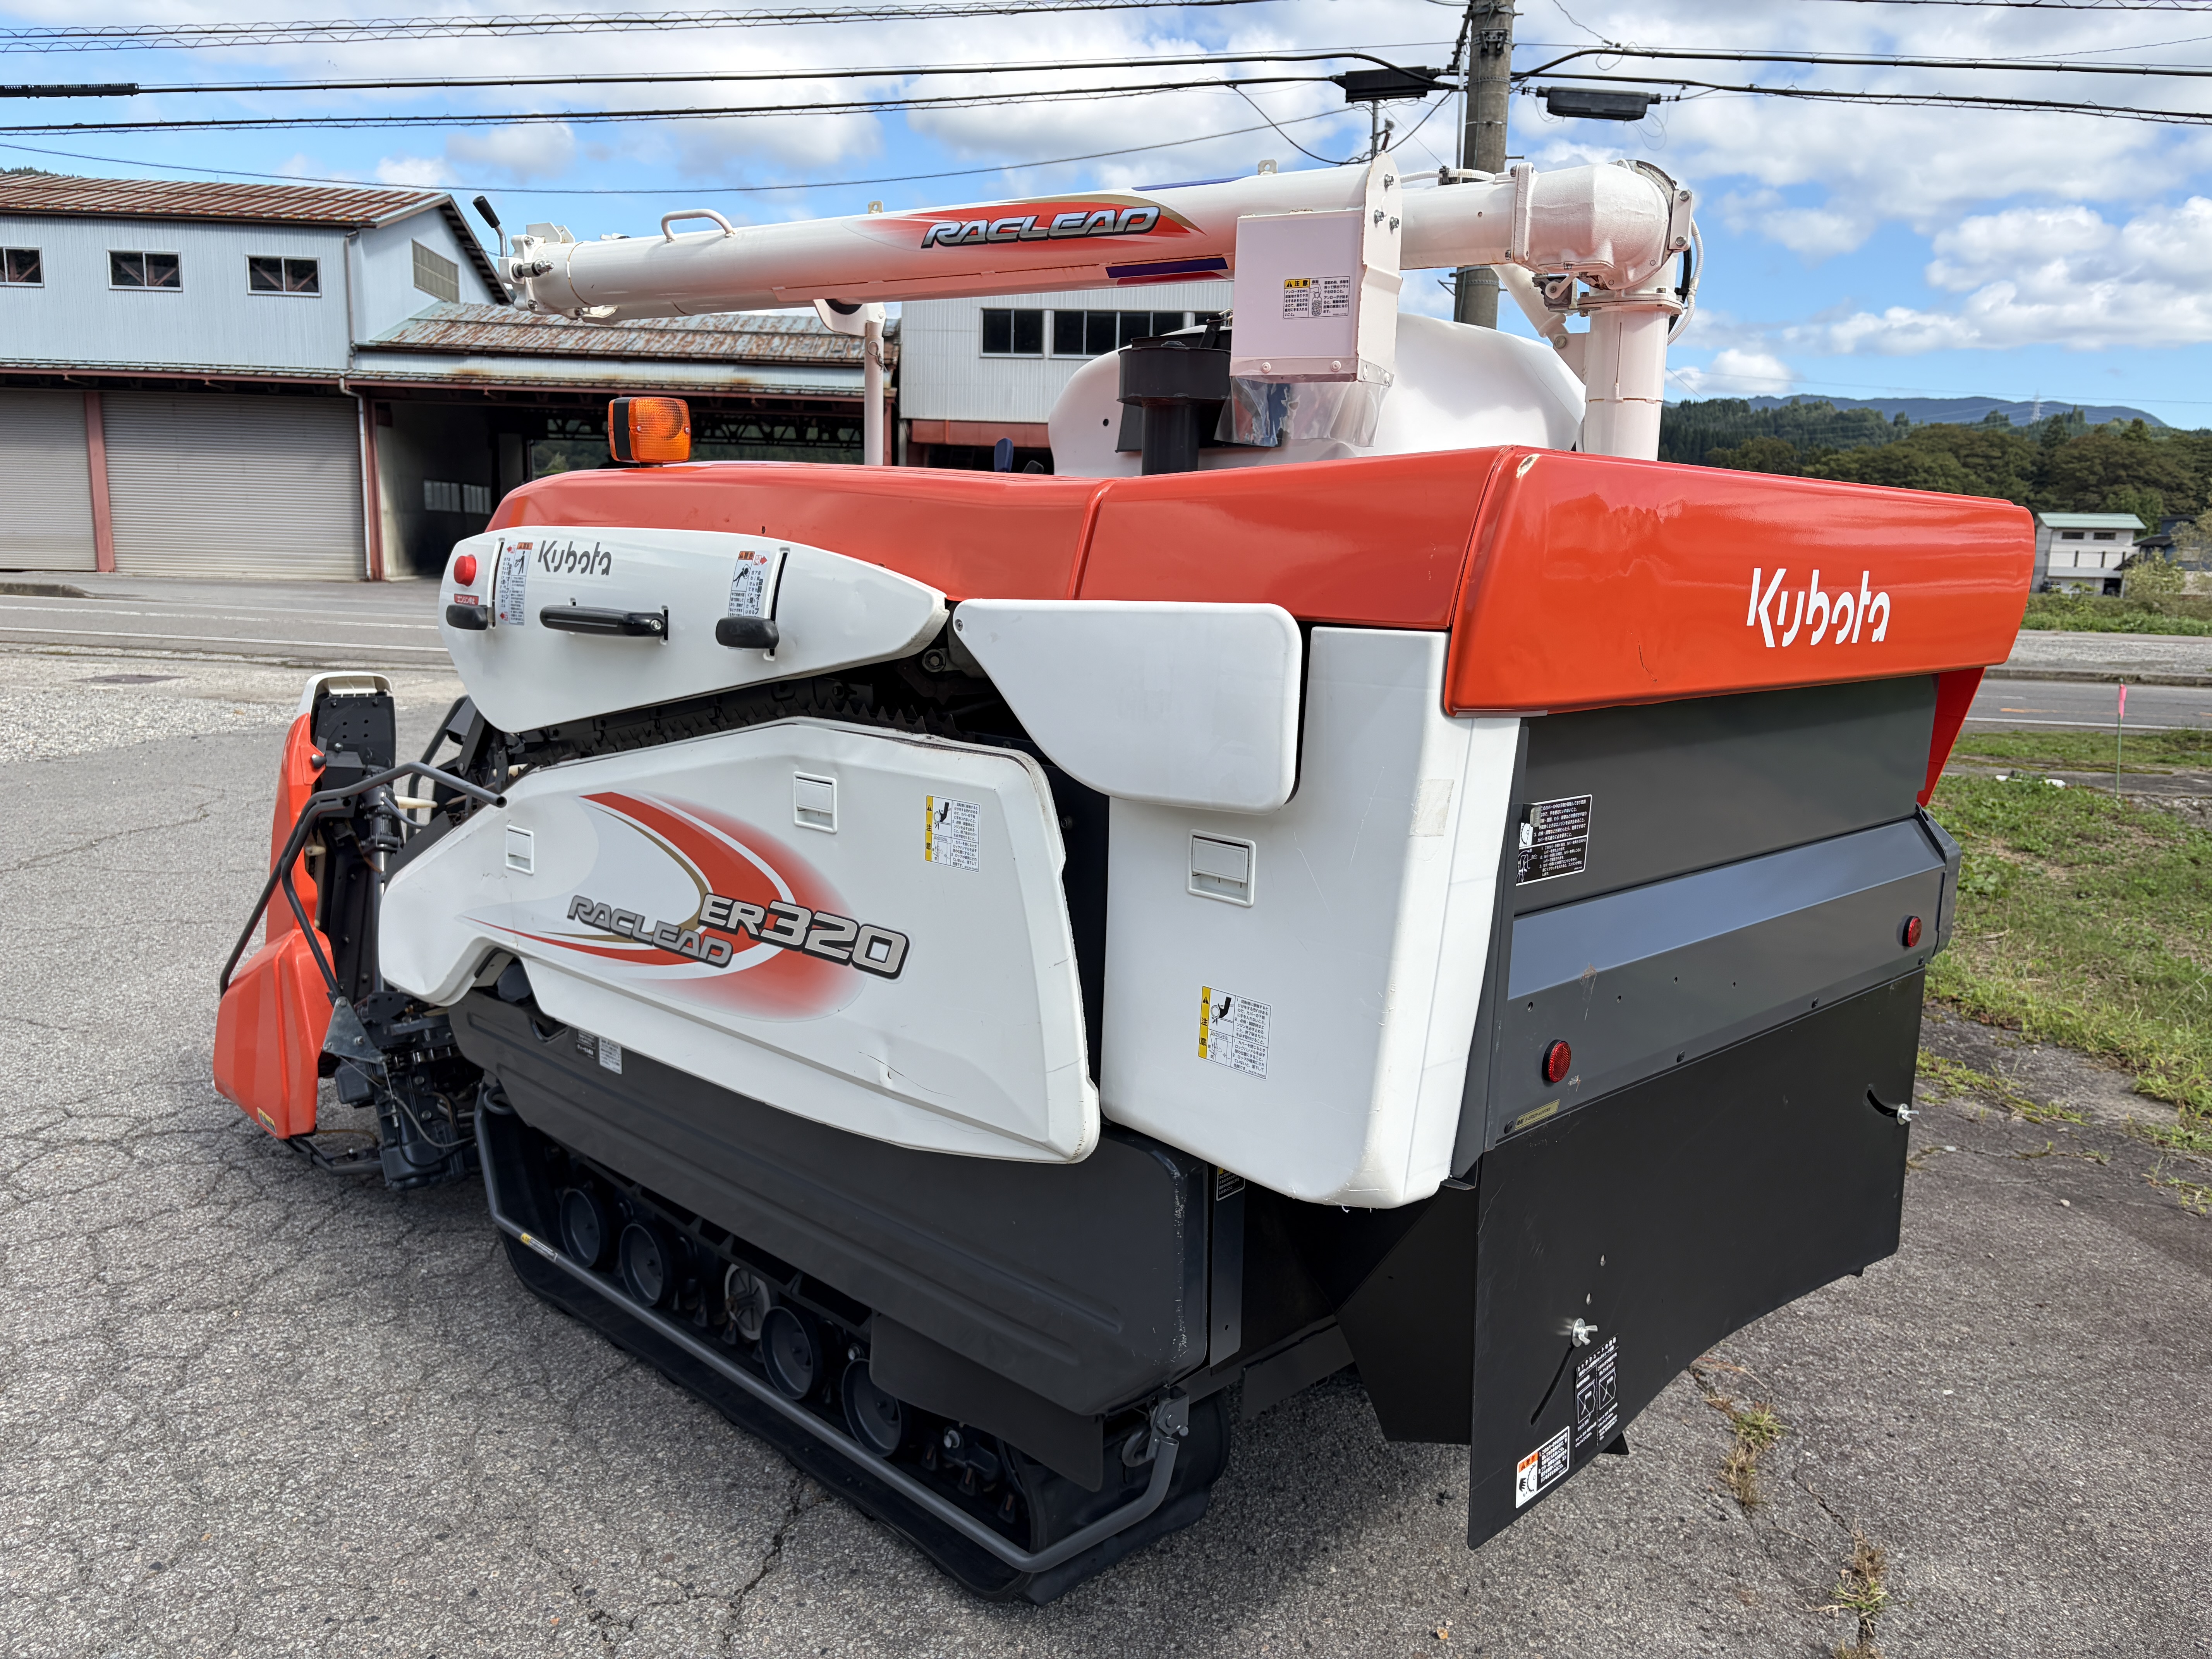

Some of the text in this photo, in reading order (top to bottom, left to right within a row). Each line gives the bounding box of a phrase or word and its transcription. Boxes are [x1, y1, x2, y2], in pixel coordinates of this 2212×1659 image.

[921, 206, 1161, 249] RACLEAD
[538, 540, 611, 576] Kubota
[1746, 567, 1891, 648] Kubota
[567, 895, 733, 969] RACLEAD
[697, 893, 910, 979] ER320
[1200, 1017, 1208, 1046] 注意
